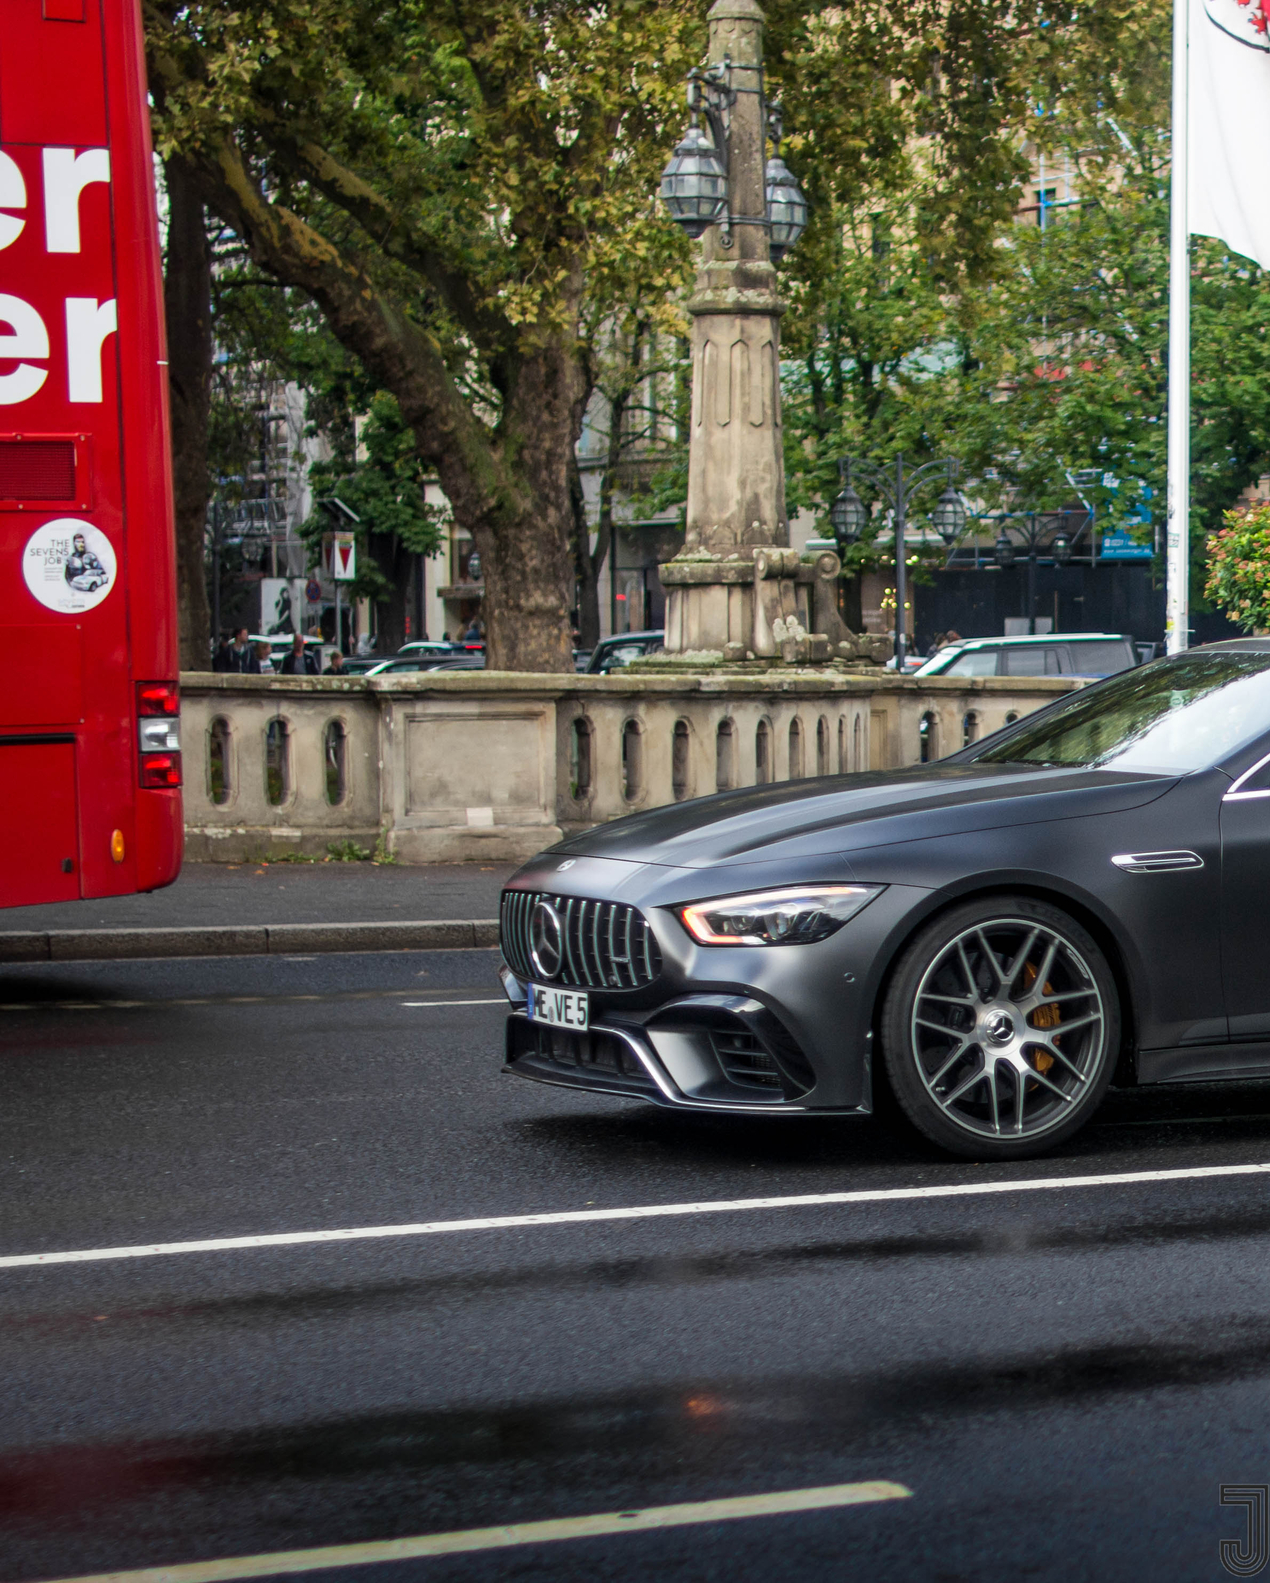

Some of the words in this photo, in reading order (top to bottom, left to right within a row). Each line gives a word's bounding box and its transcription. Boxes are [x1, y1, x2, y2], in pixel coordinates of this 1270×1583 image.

[50, 539, 70, 547] THE
[30, 548, 69, 556] SEVENS
[44, 556, 62, 566] JOB
[554, 992, 574, 1024] VE
[577, 996, 587, 1026] 5
